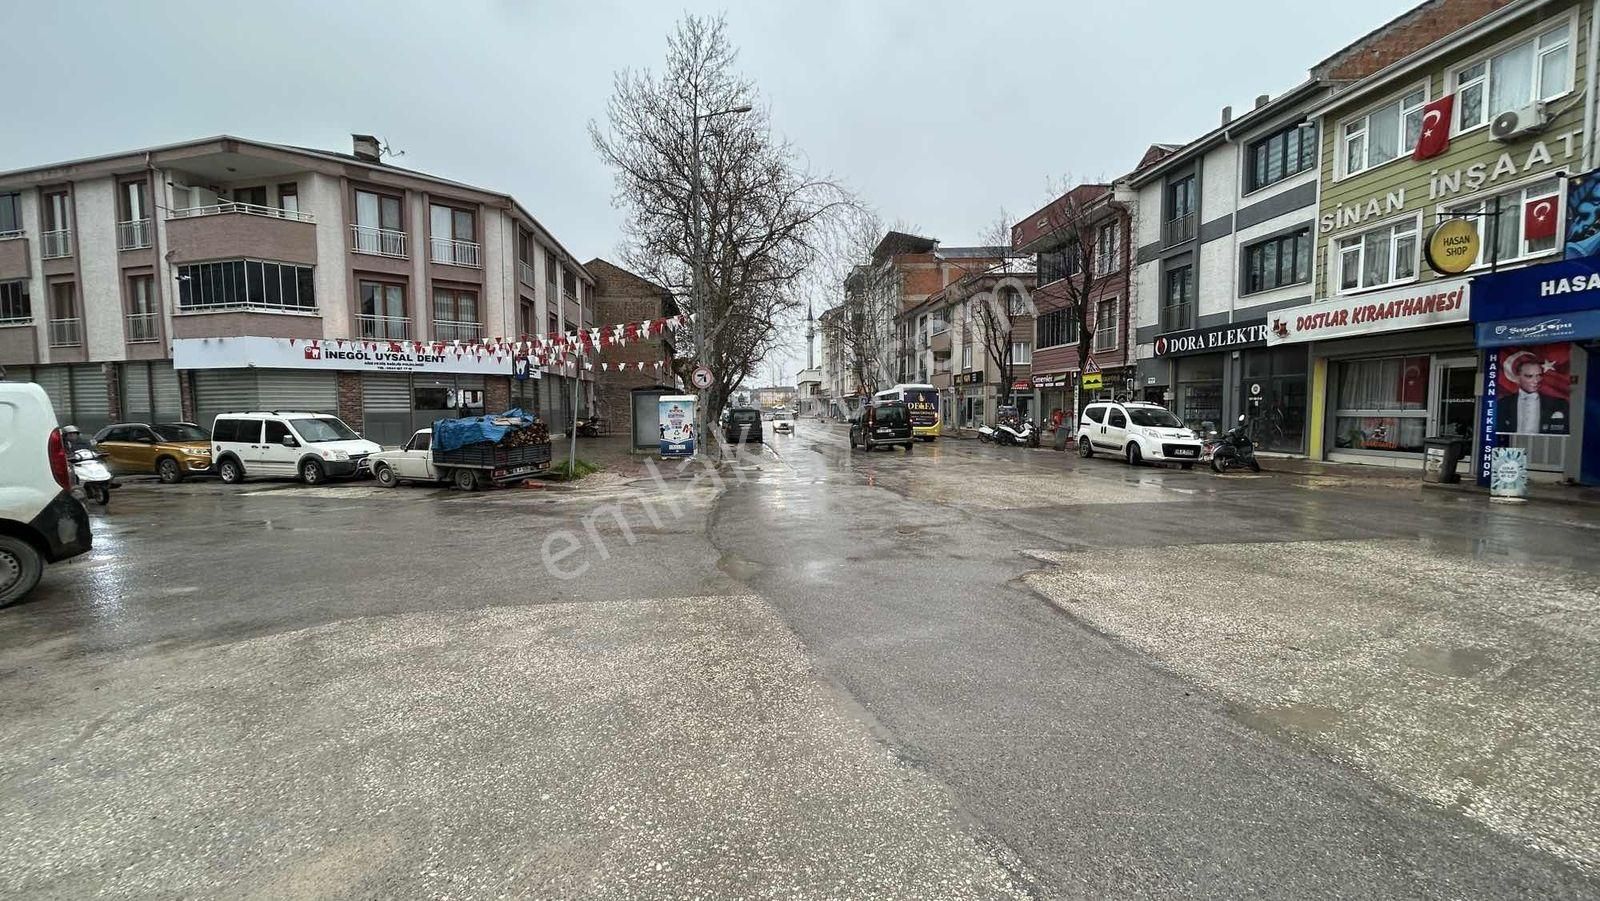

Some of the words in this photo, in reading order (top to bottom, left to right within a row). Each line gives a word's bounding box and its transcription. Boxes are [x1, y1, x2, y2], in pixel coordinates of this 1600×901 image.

[1320, 188, 1405, 233] SİNAN
[1429, 127, 1583, 200] İNŞAAT
[1443, 234, 1470, 246] HASAN
[1446, 246, 1468, 257] SHOP
[1541, 273, 1600, 296] HASA
[1296, 308, 1348, 332] DOSTLAR
[1352, 286, 1464, 324] KIRAATHANESİ
[325, 348, 371, 360] İNEGÖL
[375, 352, 413, 362] UYSAL
[417, 353, 446, 364] DENT
[1170, 332, 1205, 353] DORA
[1487, 354, 1497, 396] HASAN
[1485, 400, 1494, 442] TEKEL
[1482, 444, 1492, 478] SHOP
